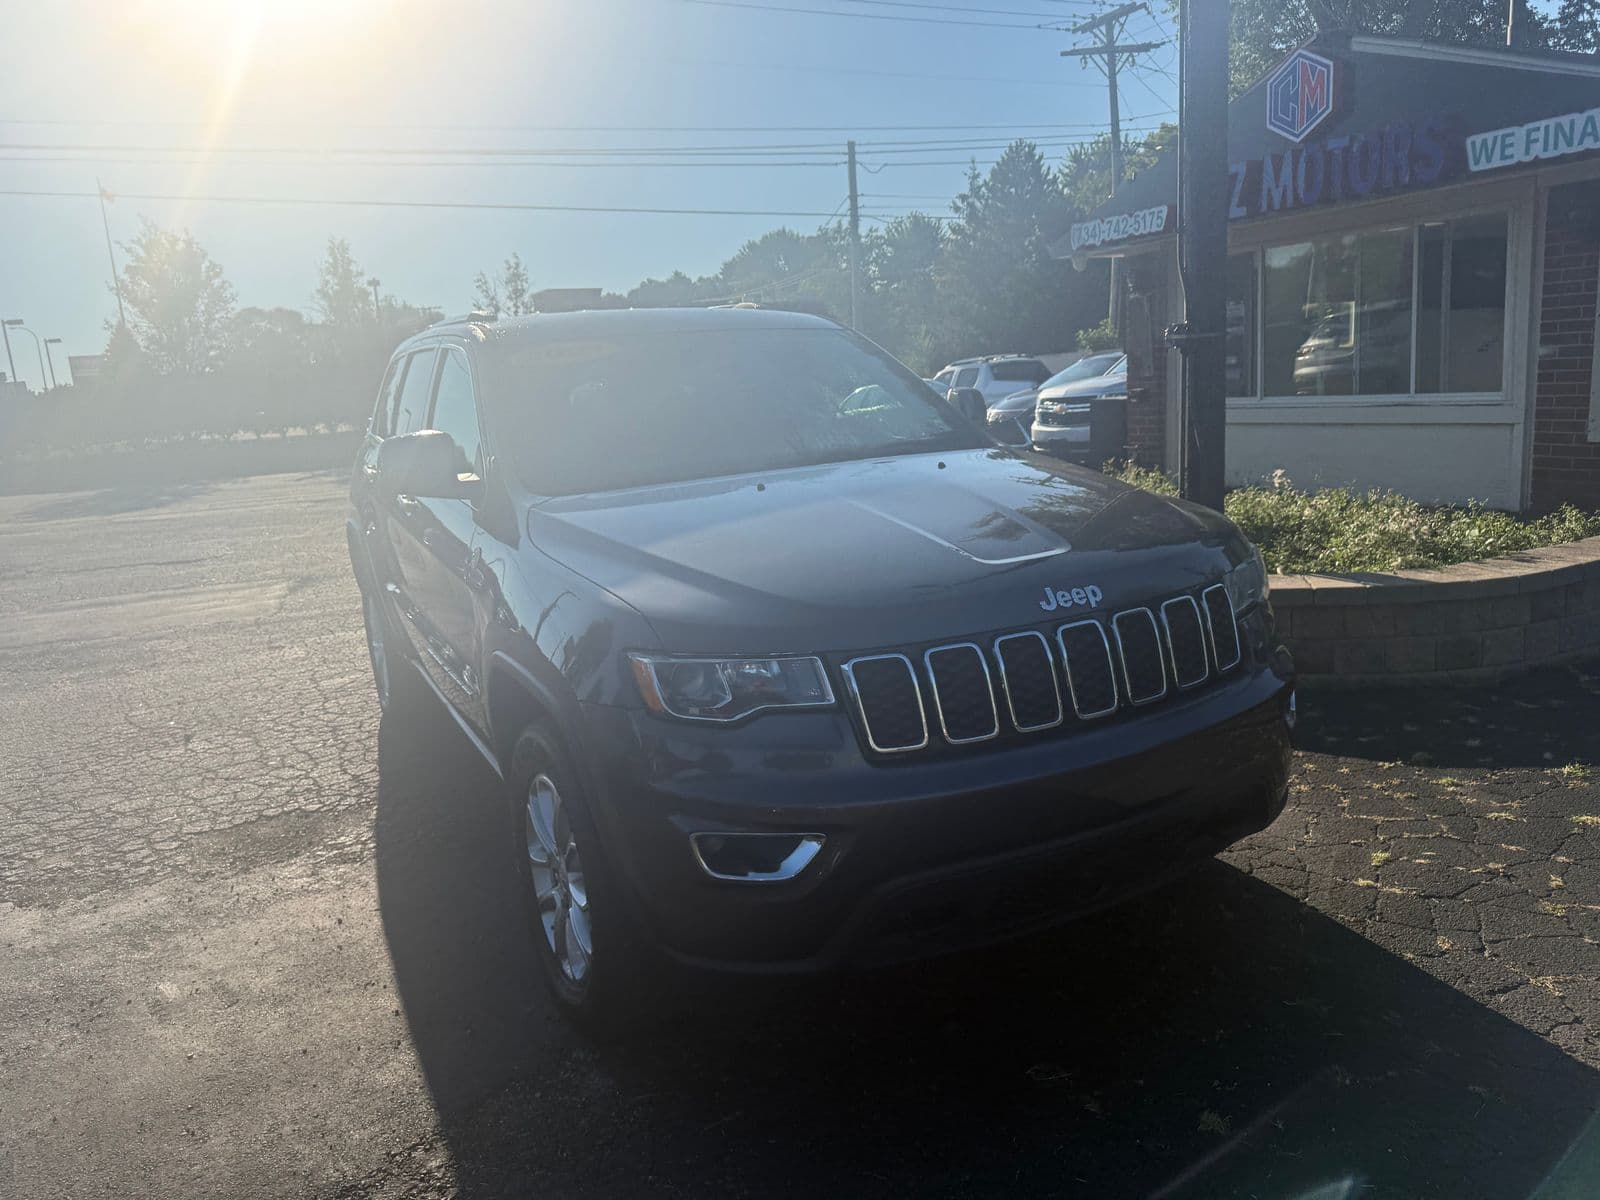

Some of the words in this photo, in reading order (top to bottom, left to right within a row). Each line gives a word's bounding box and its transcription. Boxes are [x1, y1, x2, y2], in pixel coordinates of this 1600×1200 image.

[1470, 131, 1516, 167] WE
[1524, 114, 1600, 157] FINA
[1261, 125, 1445, 213] MOTORS
[1040, 584, 1103, 611] Jeep
